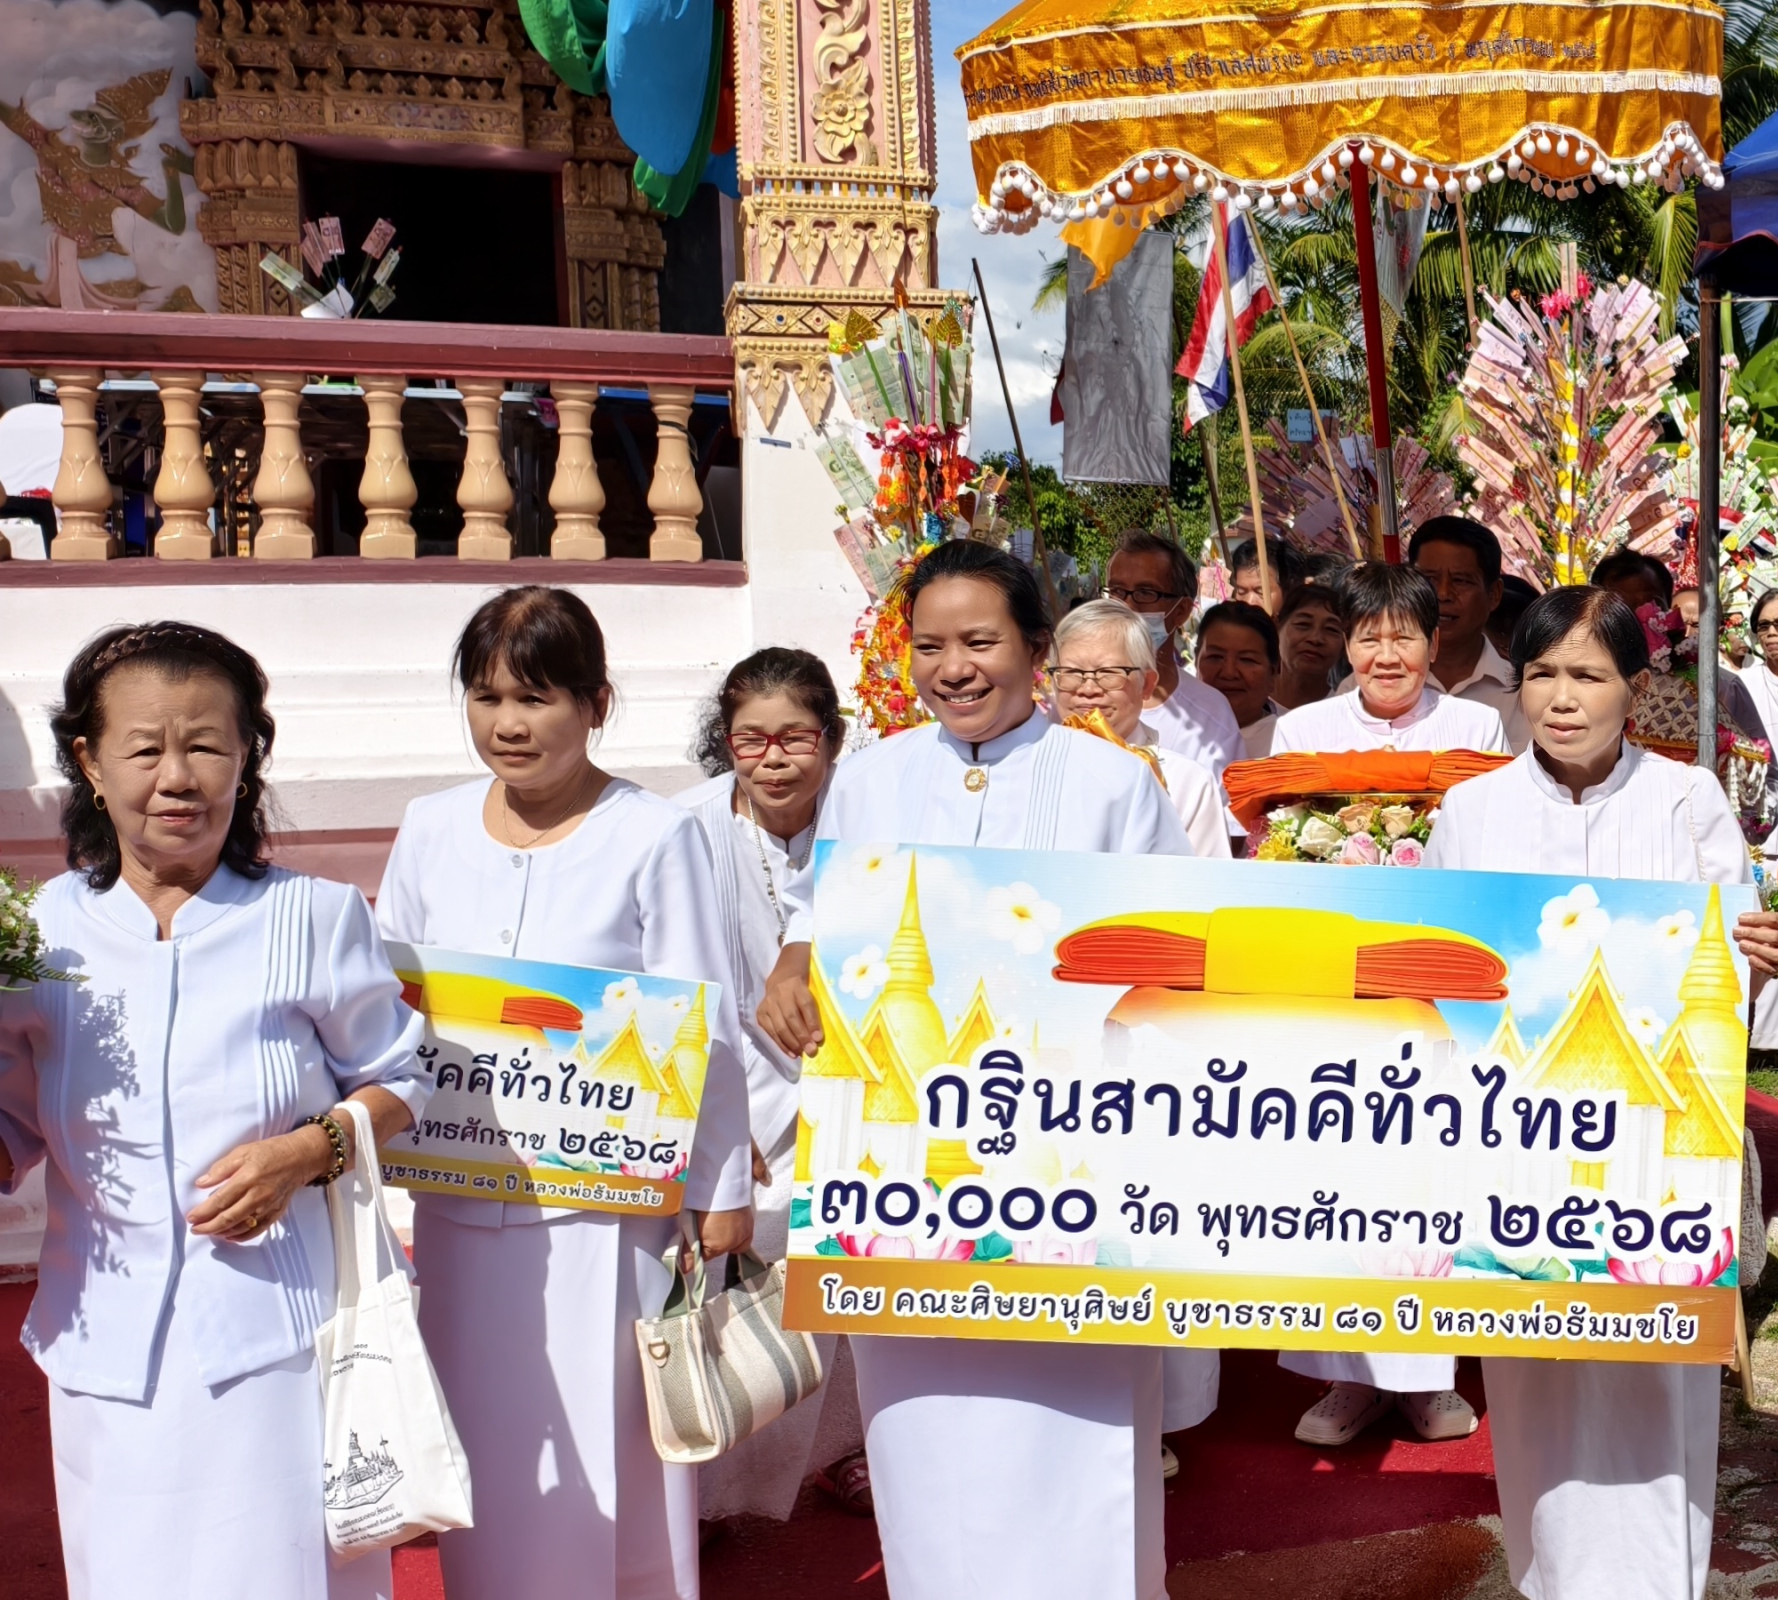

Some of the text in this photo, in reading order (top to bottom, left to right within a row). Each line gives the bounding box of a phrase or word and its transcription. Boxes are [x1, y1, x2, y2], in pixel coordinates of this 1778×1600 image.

[926, 1041, 1617, 1156] กฐินสามัคคีทั่วไทย
[558, 1127, 679, 1165] ๒๕๖๘
[381, 1163, 663, 1206] บูชาธรรม ๘๑ ปี หลวงพ่อธัมมชโย
[820, 1179, 1714, 1258] ๓๐,๐๐๐ วัด พุทธศักราช ๒๕๖๘
[821, 1277, 1697, 1341] โดย คณะศิษยานุศิษย์ บูชาธรรม ๘๑ ปี หลวงพ่อธัมมชโย
